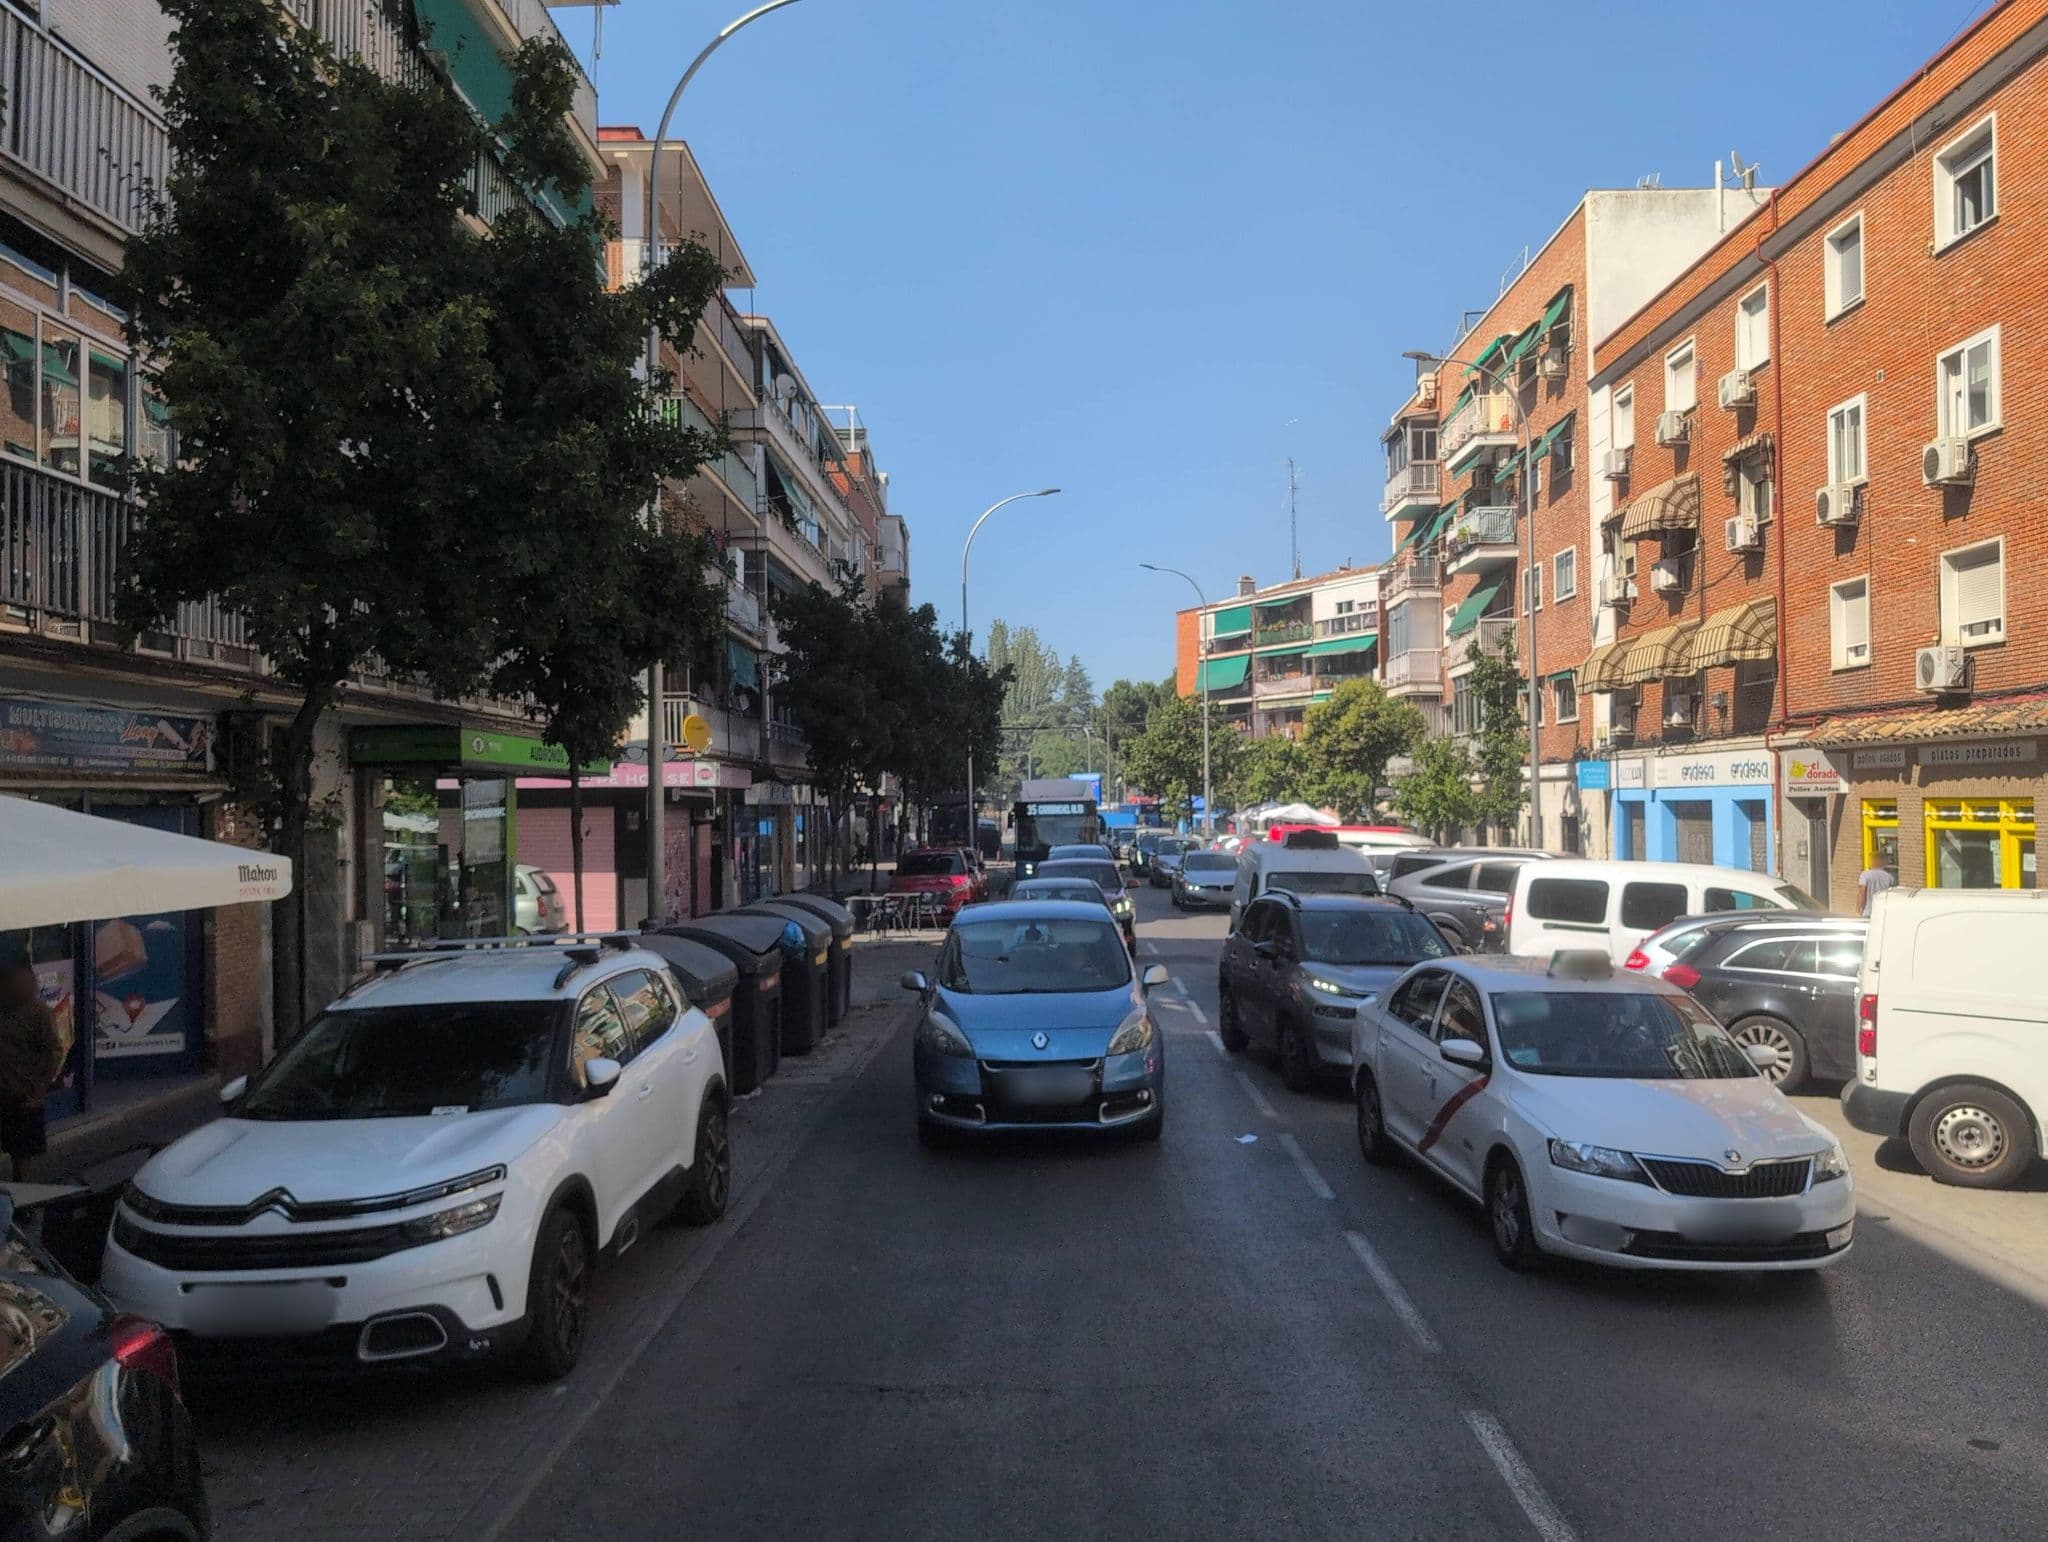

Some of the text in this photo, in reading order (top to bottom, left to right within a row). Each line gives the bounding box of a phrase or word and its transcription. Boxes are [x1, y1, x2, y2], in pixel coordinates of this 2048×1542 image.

[1811, 759, 1820, 770] el
[1931, 745, 2021, 765] platos preparados
[1681, 762, 1715, 781] endesa
[1731, 760, 1769, 779] endesa
[1807, 769, 1840, 779] dorado
[626, 773, 690, 786] HOSE
[238, 864, 278, 883] Mahou
